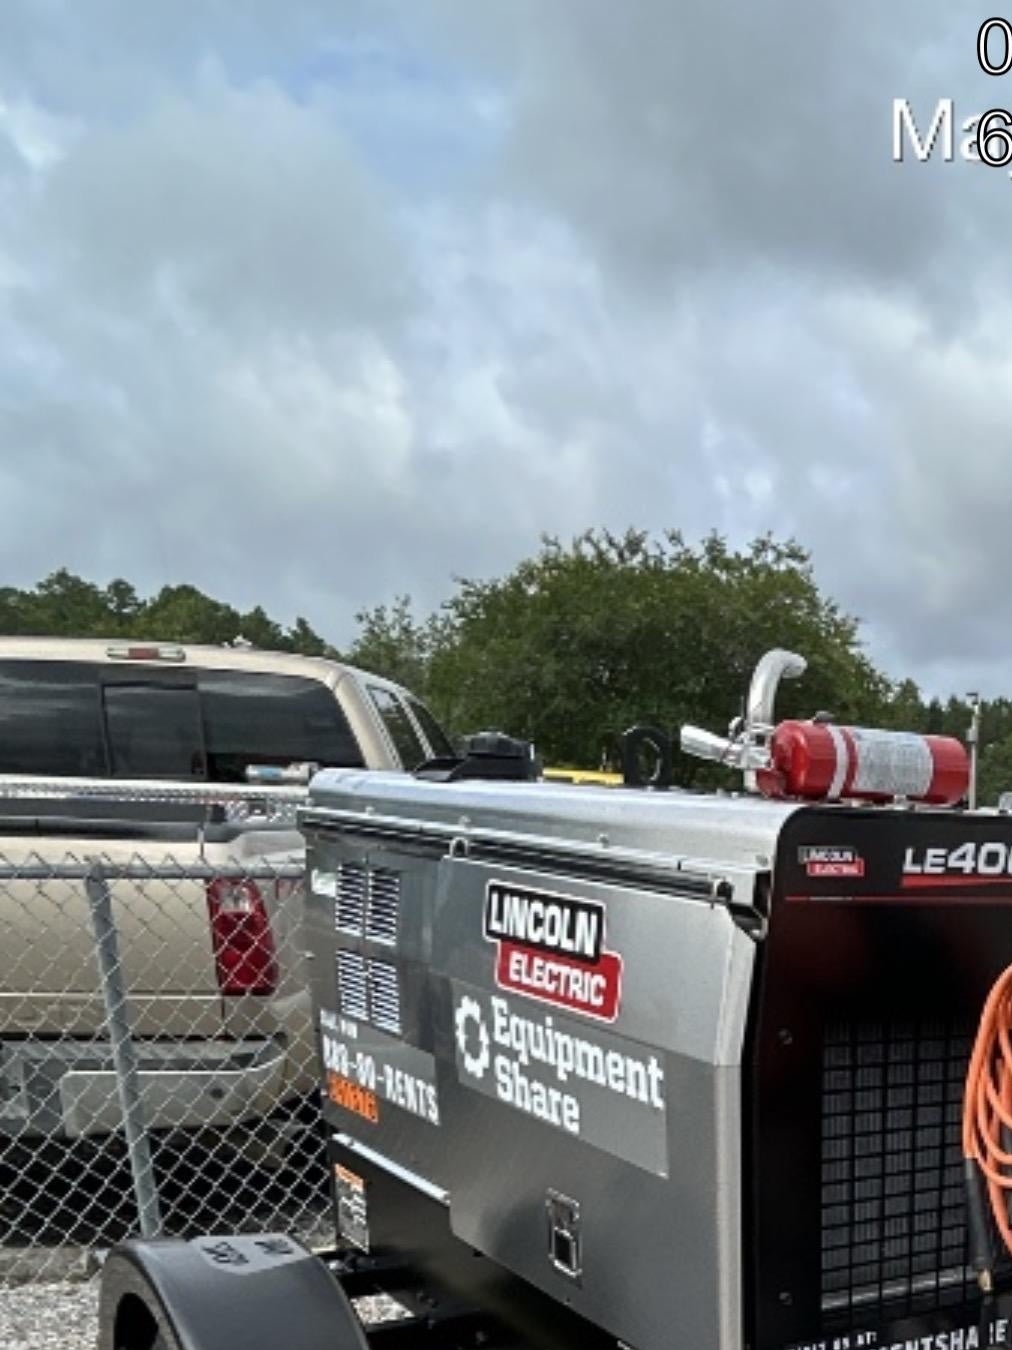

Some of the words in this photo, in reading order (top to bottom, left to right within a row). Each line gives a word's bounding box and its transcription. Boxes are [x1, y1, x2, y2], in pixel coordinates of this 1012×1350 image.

[490, 892, 598, 958] LINCOLN
[509, 951, 607, 1006] ELECTRIC
[491, 995, 665, 1111] Equipment
[495, 1054, 581, 1135] Share
